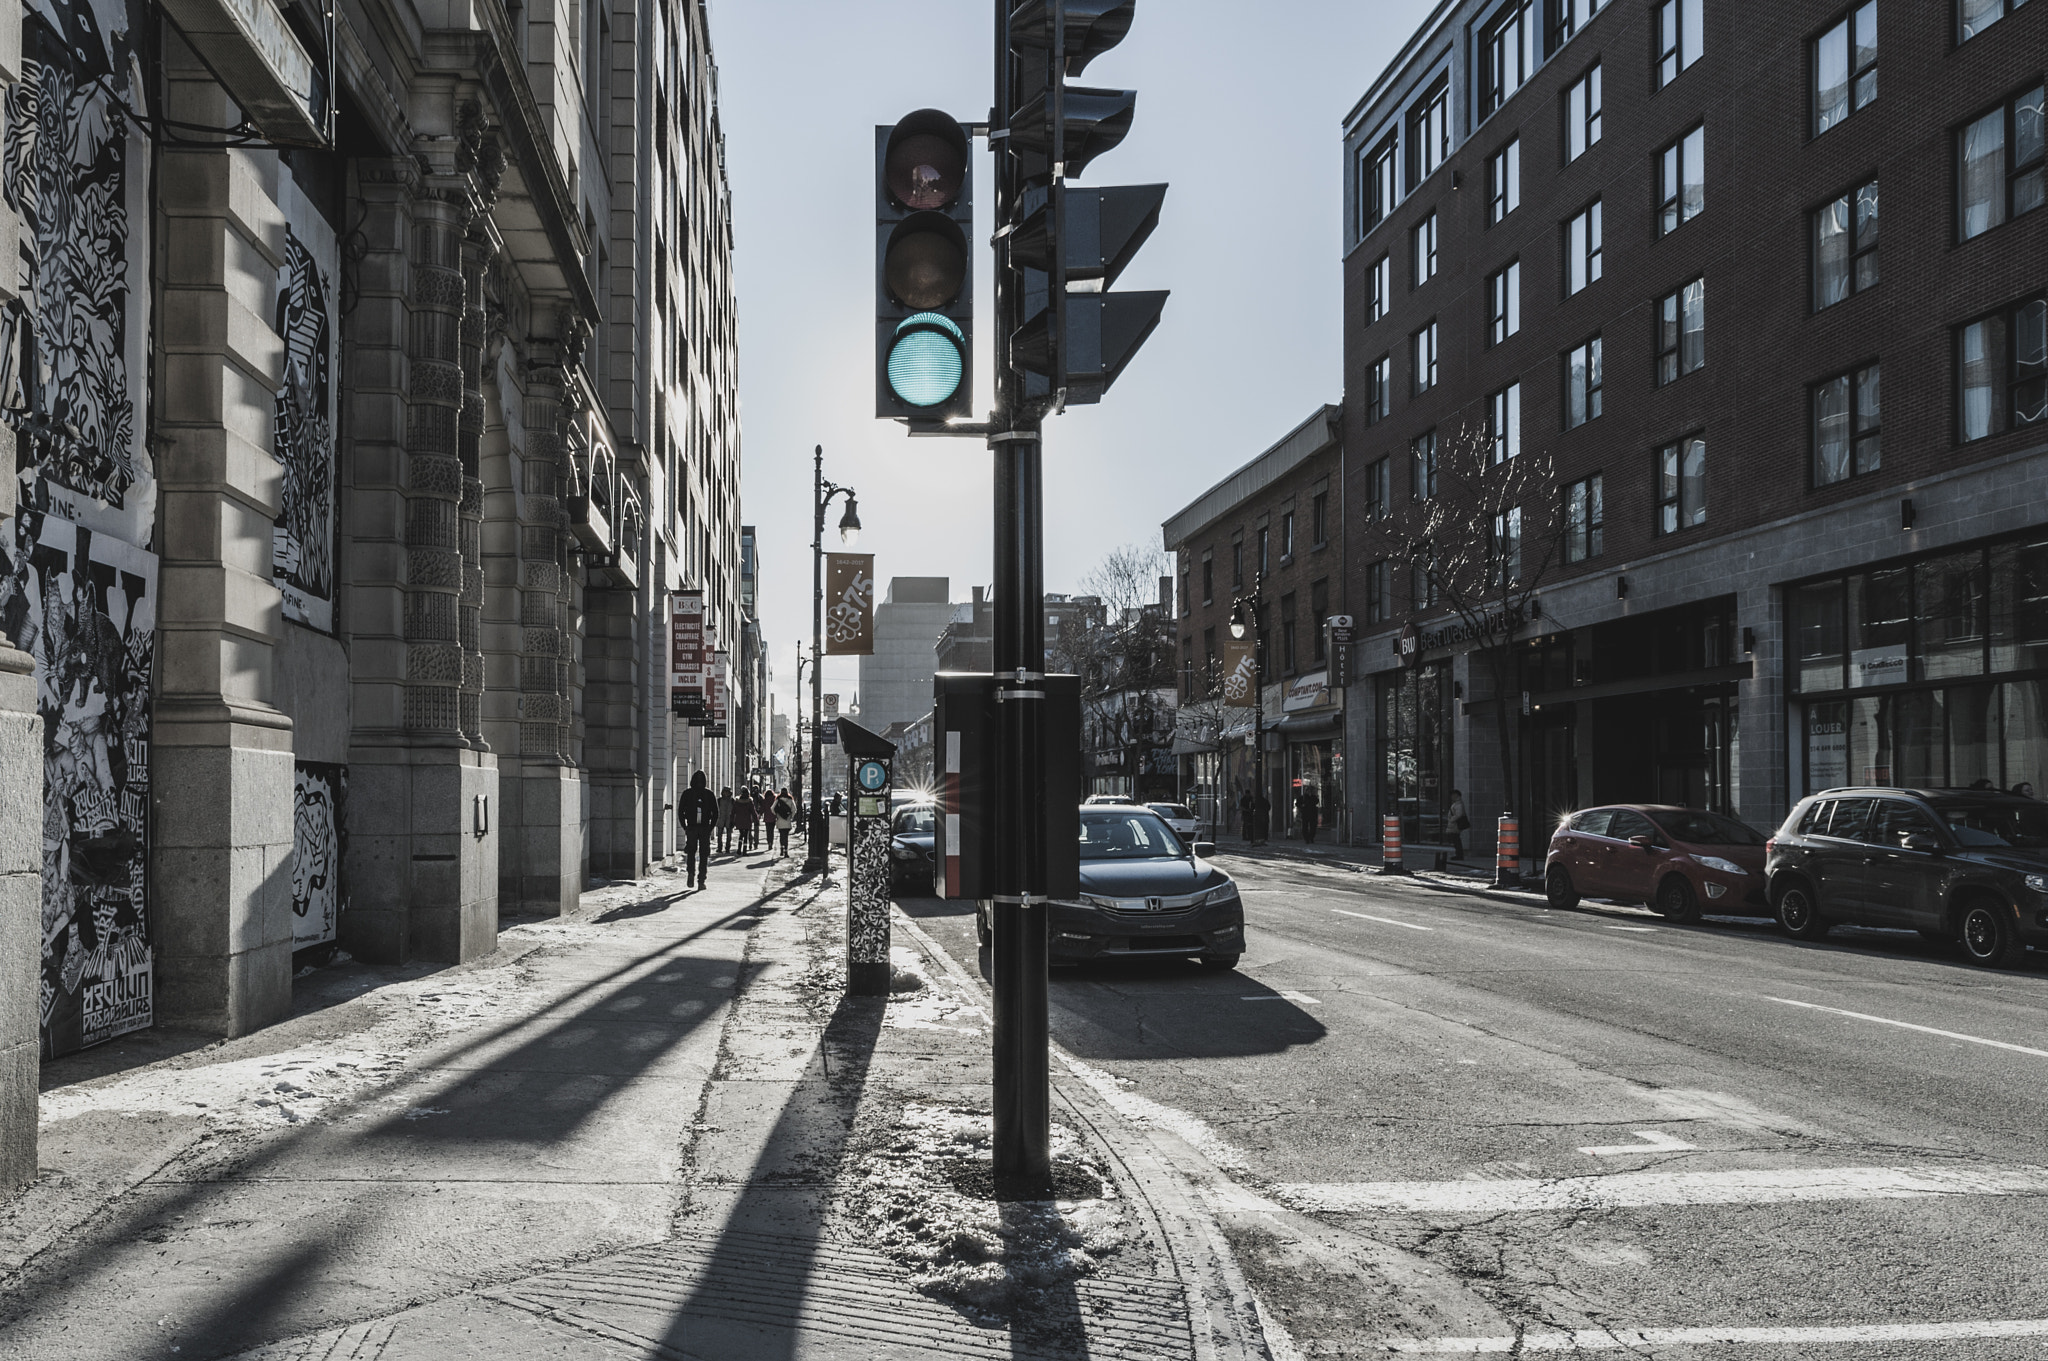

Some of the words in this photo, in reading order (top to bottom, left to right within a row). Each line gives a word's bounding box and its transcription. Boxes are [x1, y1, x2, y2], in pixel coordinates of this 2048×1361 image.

[1401, 637, 1415, 655] BW
[1420, 631, 1441, 650] Best
[682, 652, 693, 660] GYM
[678, 675, 697, 684] INCLUS
[1811, 722, 1842, 734] LOUER
